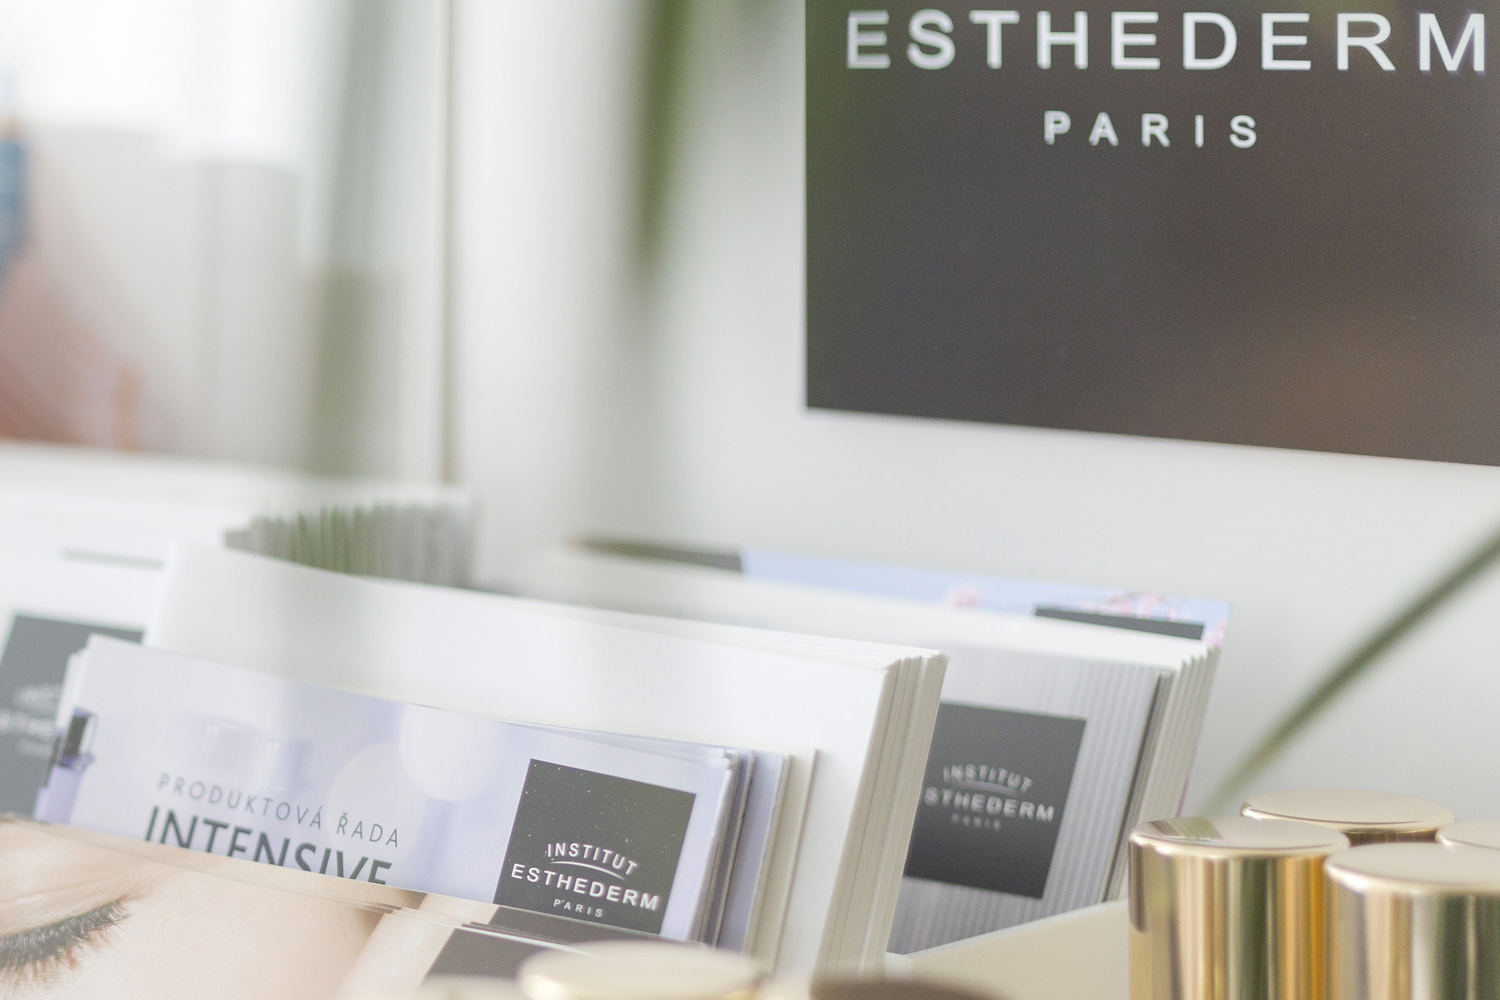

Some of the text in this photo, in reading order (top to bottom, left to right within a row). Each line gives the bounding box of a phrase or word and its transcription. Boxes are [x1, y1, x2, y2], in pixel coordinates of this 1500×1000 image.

[846, 8, 1486, 72] ESTHEDERM
[1043, 109, 1257, 149] PARIS
[943, 764, 1033, 795] INSTITUT
[158, 772, 399, 848] PRODUKTOVÁ ŘADA
[923, 786, 1056, 823] STHEDERM
[547, 842, 638, 876] INSTITUT
[510, 863, 661, 912] ESTHEDERM
[553, 898, 604, 918] PARIS
